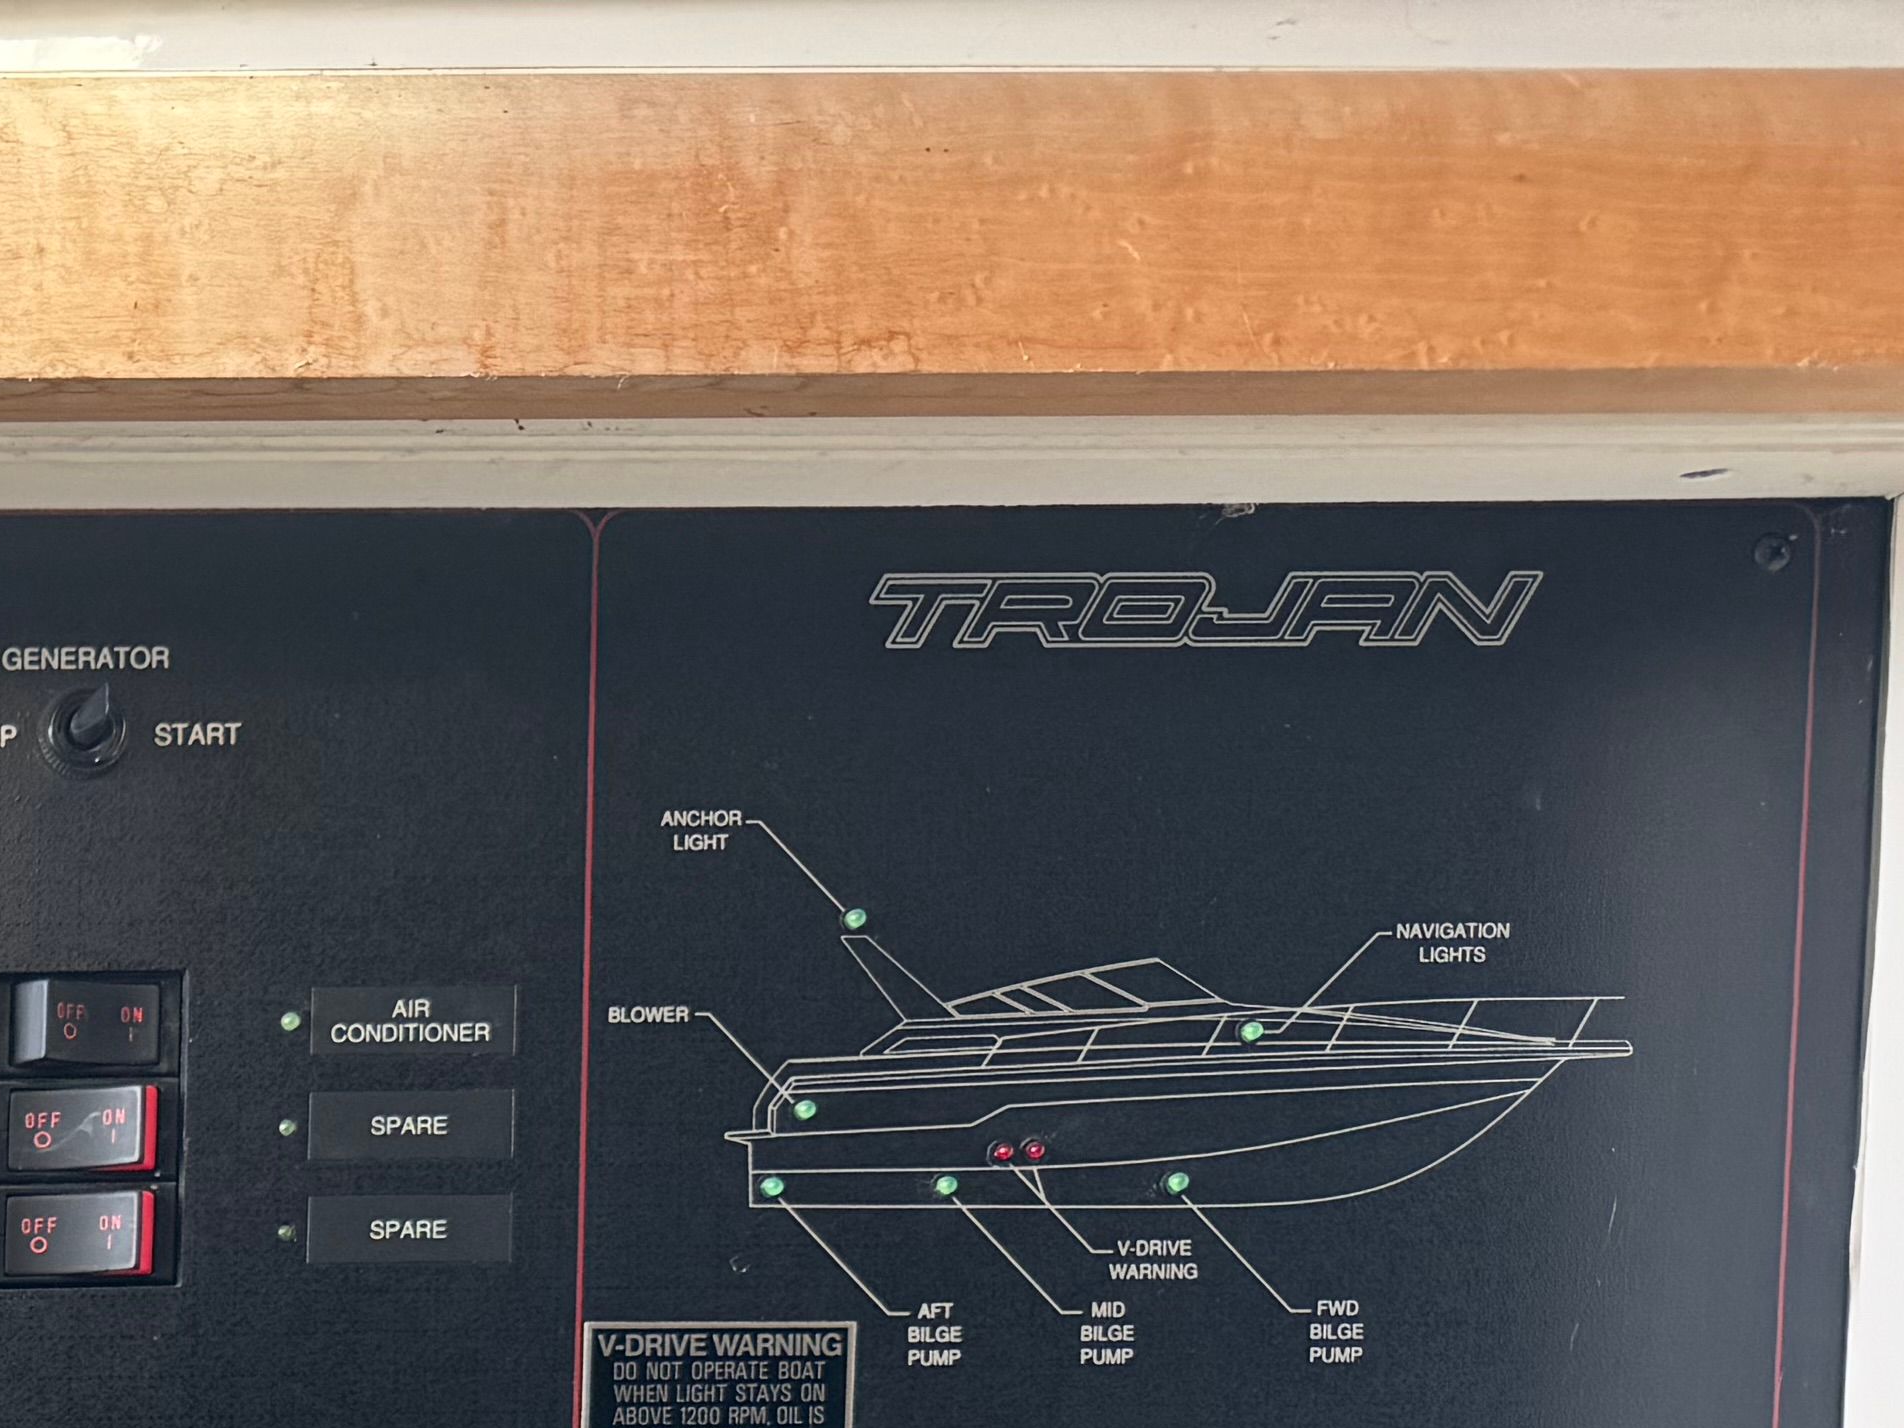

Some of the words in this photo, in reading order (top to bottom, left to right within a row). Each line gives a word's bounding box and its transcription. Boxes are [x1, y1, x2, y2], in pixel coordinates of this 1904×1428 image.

[869, 570, 1544, 648] TROJAN
[1, 646, 170, 671] GENERATOR
[154, 722, 242, 747] START
[660, 809, 742, 827] ANCHOR
[673, 833, 729, 851] LIGHT
[1396, 922, 1511, 940] NAVIGATION
[1419, 946, 1486, 963] LIGHTS
[391, 998, 431, 1018] AIR
[608, 1005, 689, 1024] BLOWER
[330, 1022, 490, 1043] CONDITIONER
[1117, 1239, 1192, 1257] V-DRIVE
[1108, 1262, 1199, 1280] WARNING
[1317, 1299, 1360, 1317] FWD
[1309, 1322, 1364, 1340] BILGE
[597, 1333, 708, 1357] V-DRIVE
[712, 1332, 842, 1357] WARNING
[1309, 1346, 1363, 1364] PUMP
[613, 1361, 637, 1381] DO
[646, 1361, 683, 1381] NOT
[691, 1360, 769, 1380] OPERATE
[778, 1360, 826, 1380] BOAT
[613, 1383, 669, 1403] WHEN
[676, 1383, 728, 1403] LIGHT
[735, 1382, 792, 1403] STAYS
[800, 1382, 826, 1402] ON
[612, 1405, 673, 1426] ABOVE
[680, 1406, 721, 1425] 1200
[776, 1405, 803, 1425] OIL
[808, 1405, 825, 1425] IS
